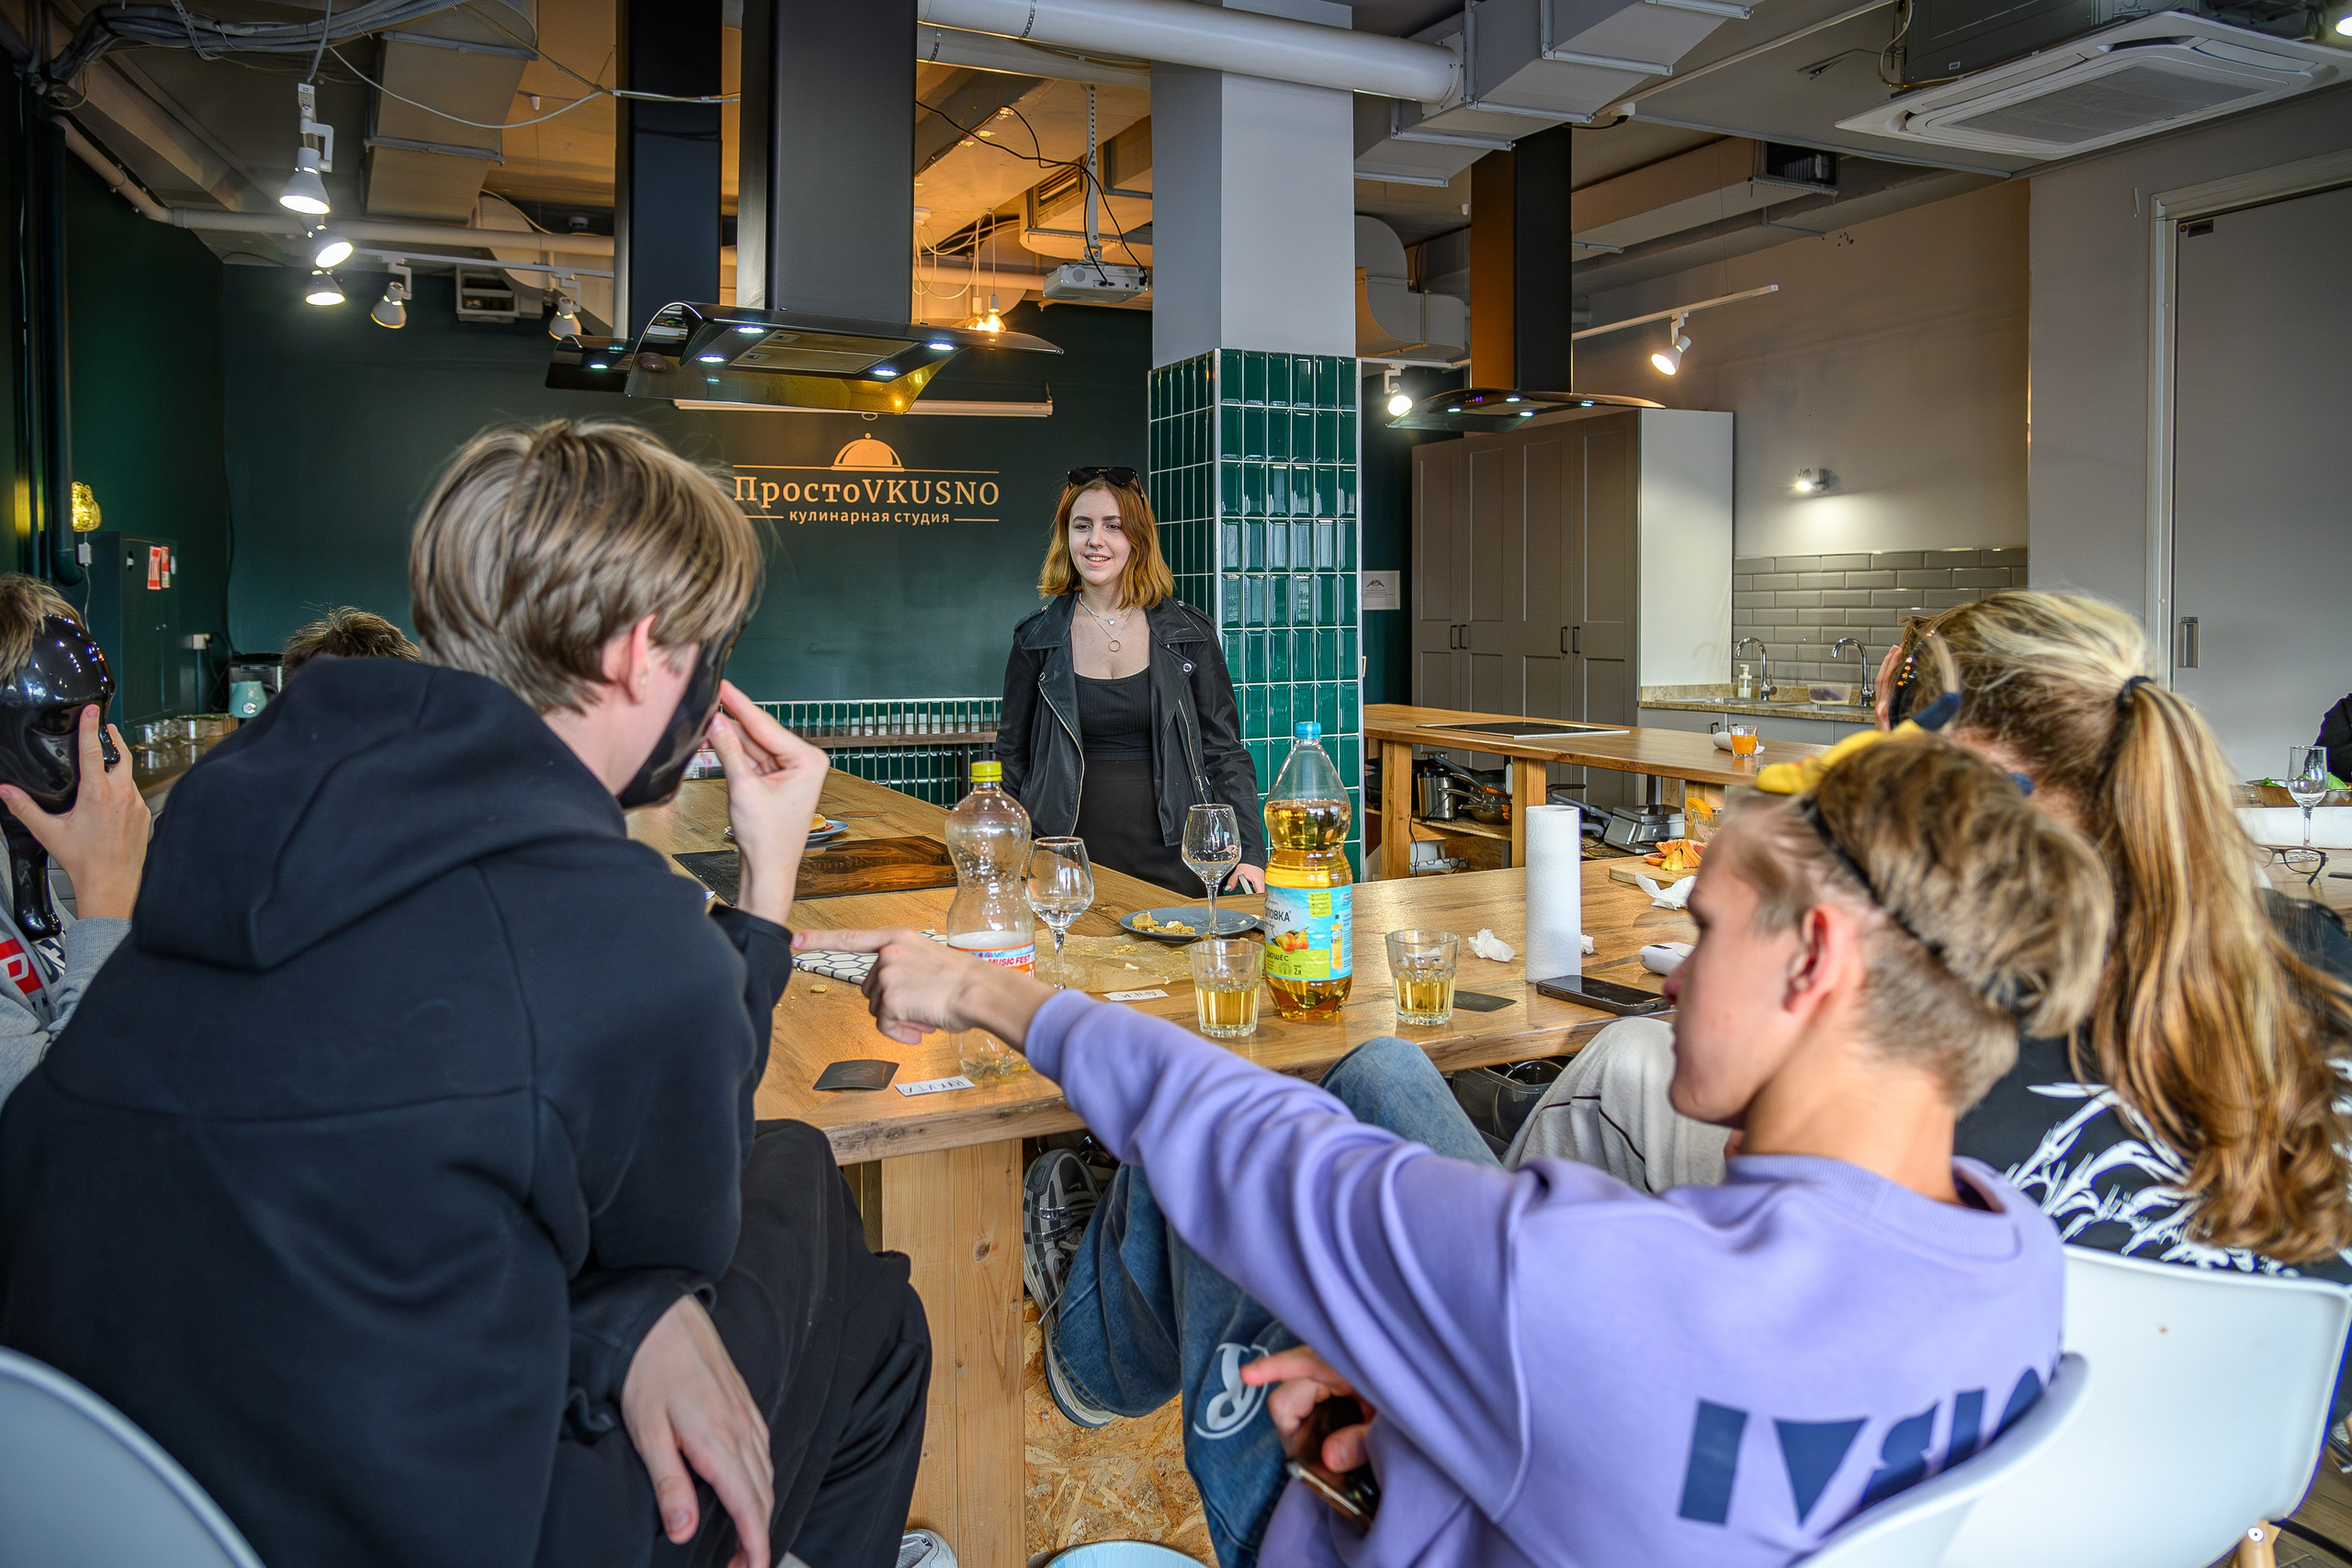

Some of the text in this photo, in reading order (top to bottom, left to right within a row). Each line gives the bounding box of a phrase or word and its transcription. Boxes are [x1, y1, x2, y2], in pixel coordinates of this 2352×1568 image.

[789, 509, 950, 526] кулинарная студия
[1015, 953, 1031, 964] FEST
